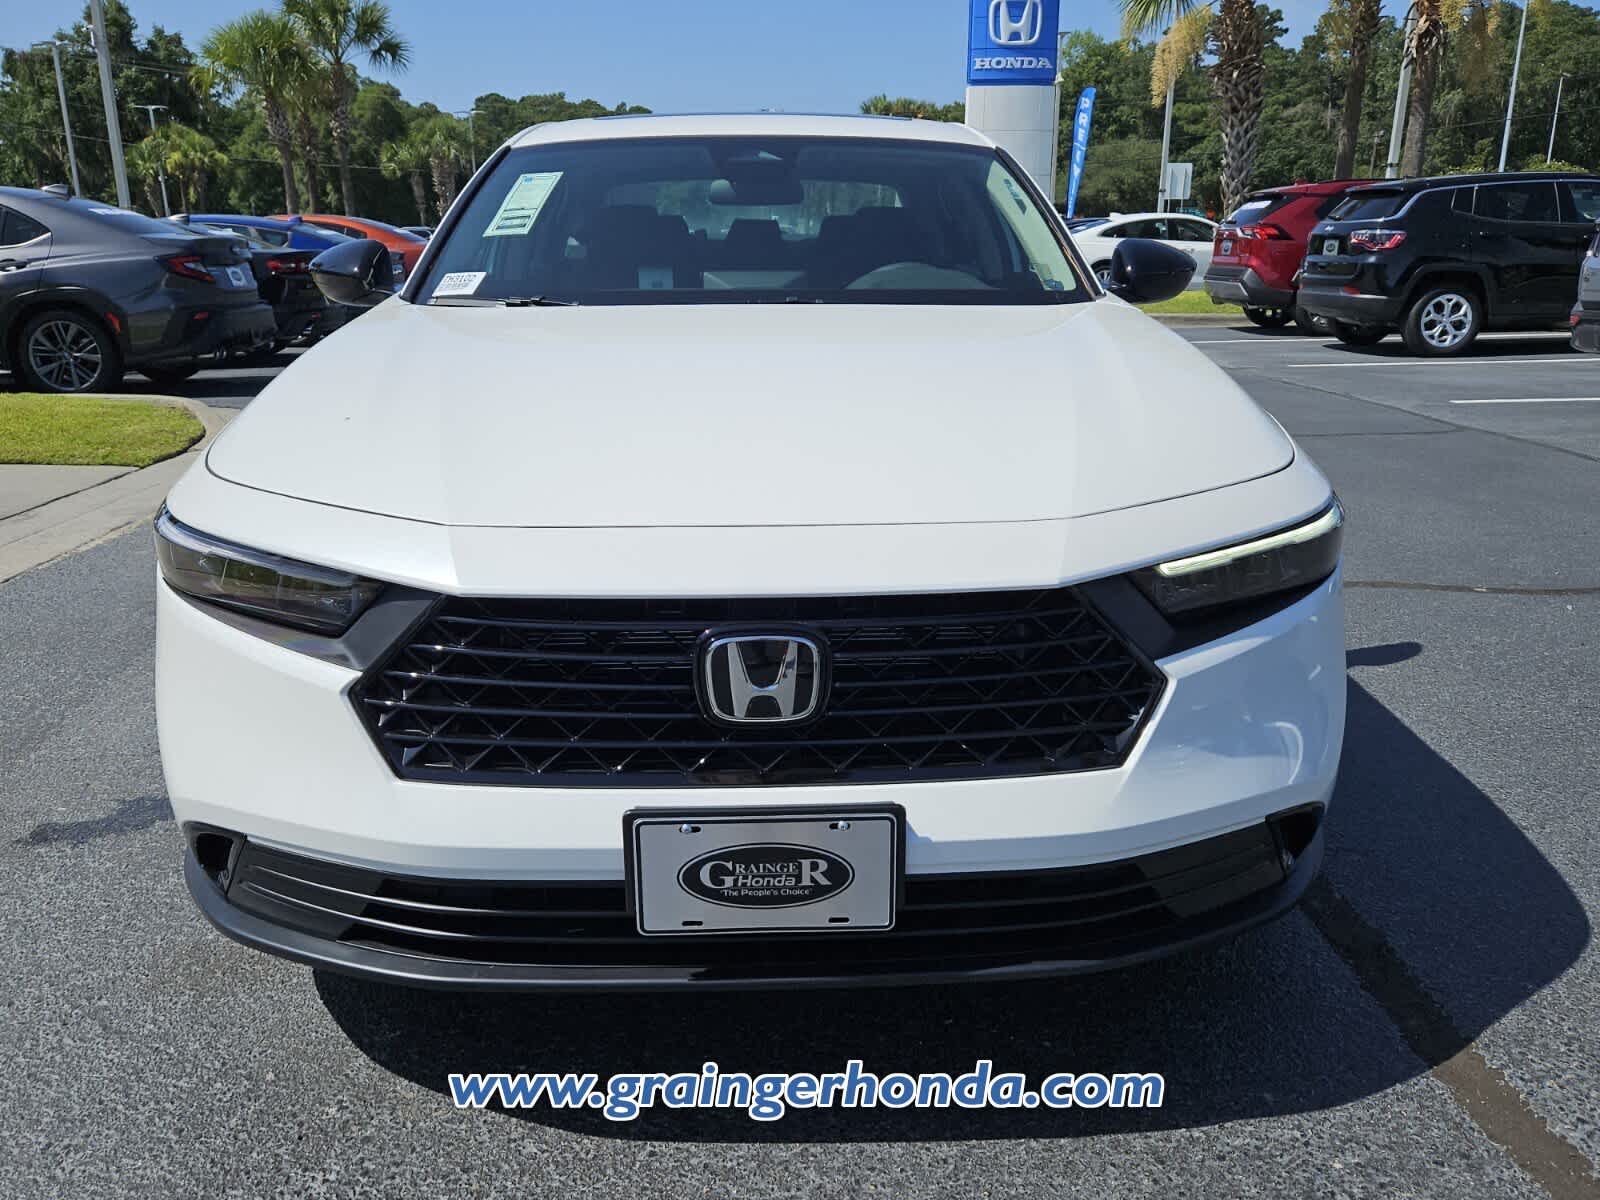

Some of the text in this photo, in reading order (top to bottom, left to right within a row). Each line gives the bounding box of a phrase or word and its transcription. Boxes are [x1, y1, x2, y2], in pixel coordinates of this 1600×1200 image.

[974, 57, 1053, 69] HONDA
[700, 858, 832, 889] GRAINGER
[738, 875, 796, 887] Honda
